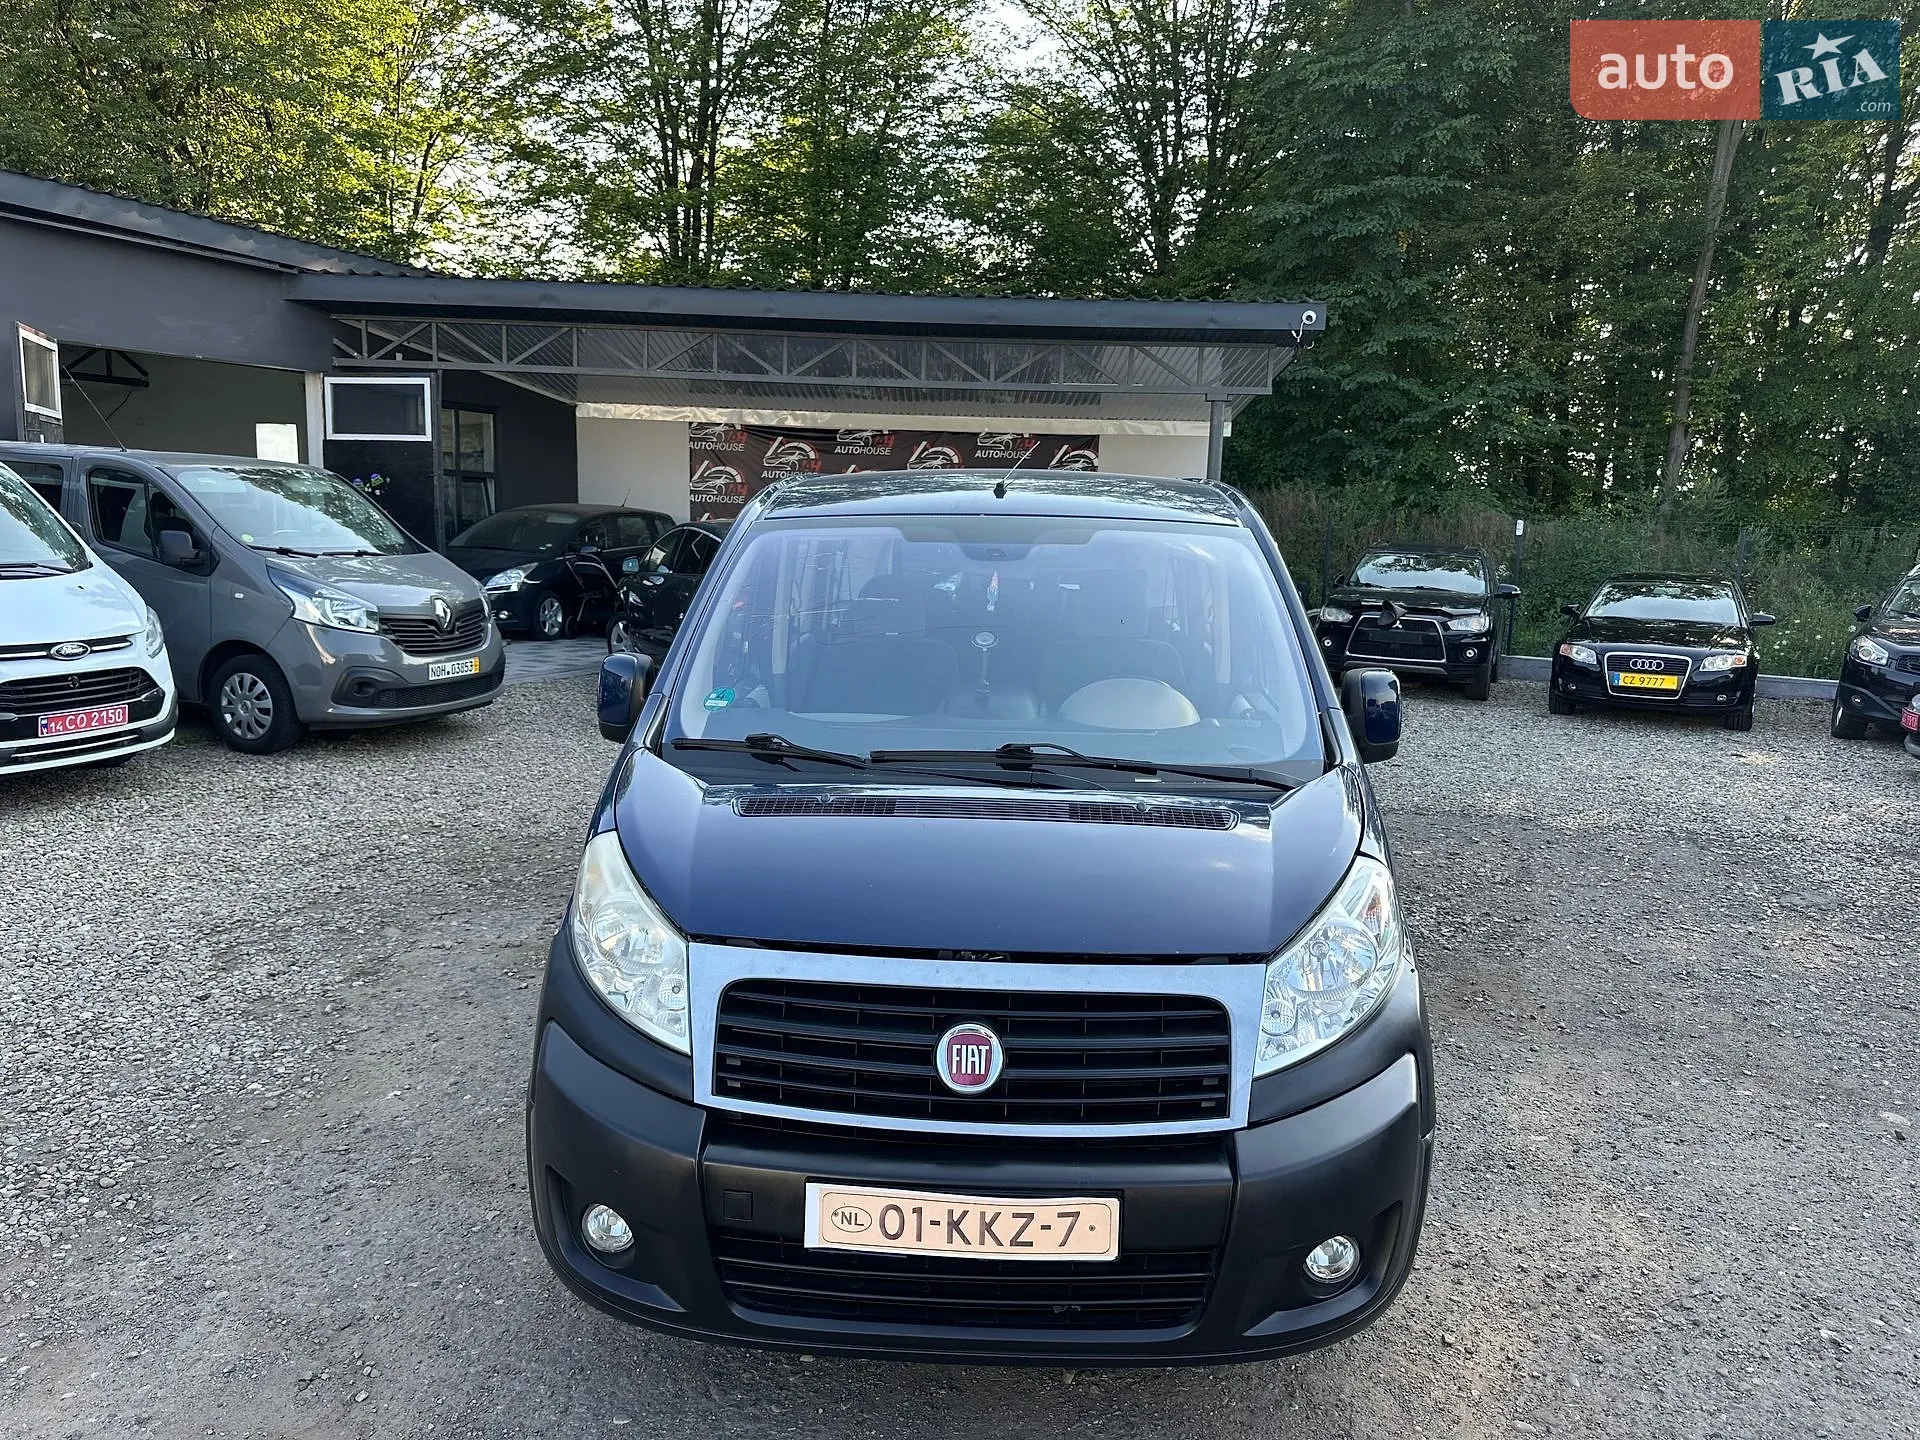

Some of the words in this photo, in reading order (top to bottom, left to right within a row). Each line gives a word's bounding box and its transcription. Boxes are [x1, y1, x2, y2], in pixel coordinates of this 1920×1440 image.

[689, 441, 745, 452] AUTOHOUSE
[834, 446, 892, 456] AUTOHOUSE
[974, 450, 1032, 460] AUTOHOUSE
[689, 494, 745, 504] AUTOHOUSE
[1622, 676, 1635, 685] CZ
[1639, 677, 1665, 687] 9777
[49, 721, 63, 733] 14
[65, 713, 87, 729] CO
[91, 709, 123, 726] 2150
[952, 1044, 990, 1075] FIAT
[840, 1213, 865, 1228] NL
[879, 1203, 1081, 1248] 01-KKZ-7
